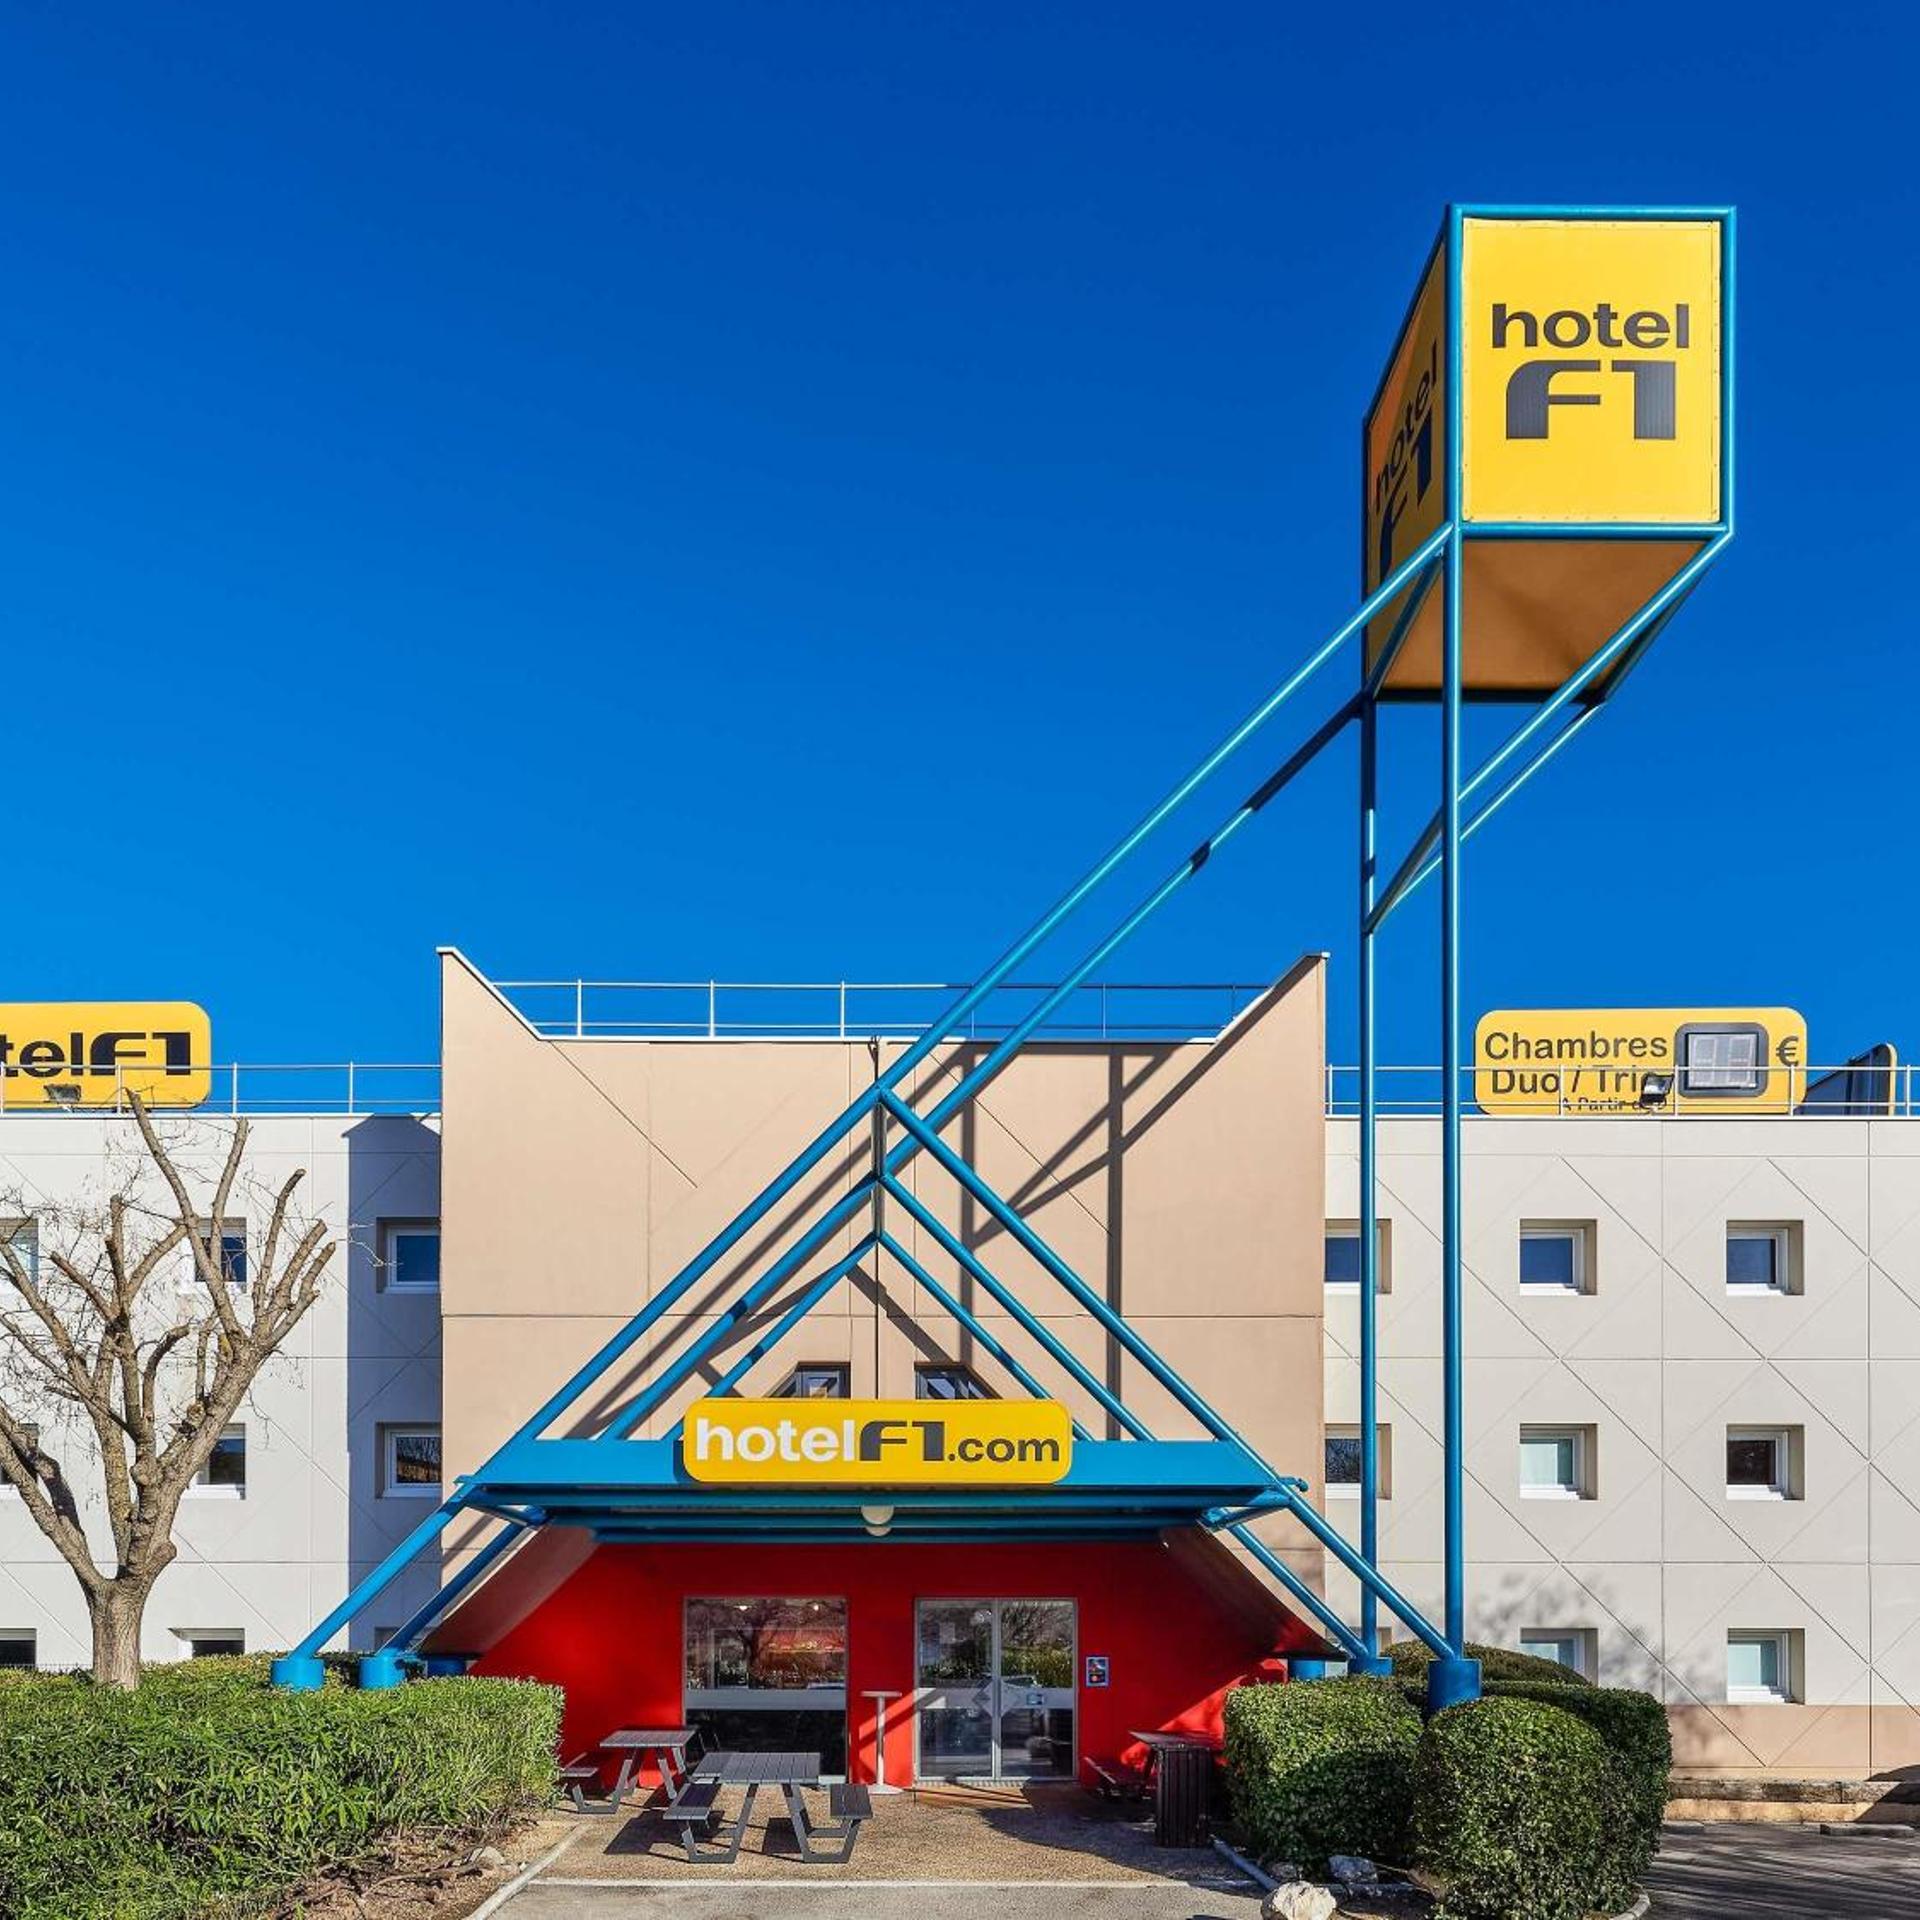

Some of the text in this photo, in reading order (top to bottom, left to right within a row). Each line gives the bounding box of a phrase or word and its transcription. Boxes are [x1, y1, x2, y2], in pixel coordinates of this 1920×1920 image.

[1492, 303, 1689, 348] hotel
[1506, 359, 1677, 440] F1
[1375, 338, 1438, 516] hotel
[1485, 1031, 1668, 1060] Chambres
[1775, 1035, 1799, 1067] €
[1492, 1067, 1560, 1094] Duo
[1592, 1065, 1660, 1093] Tri
[695, 1418, 1060, 1463] hotelF1.com
